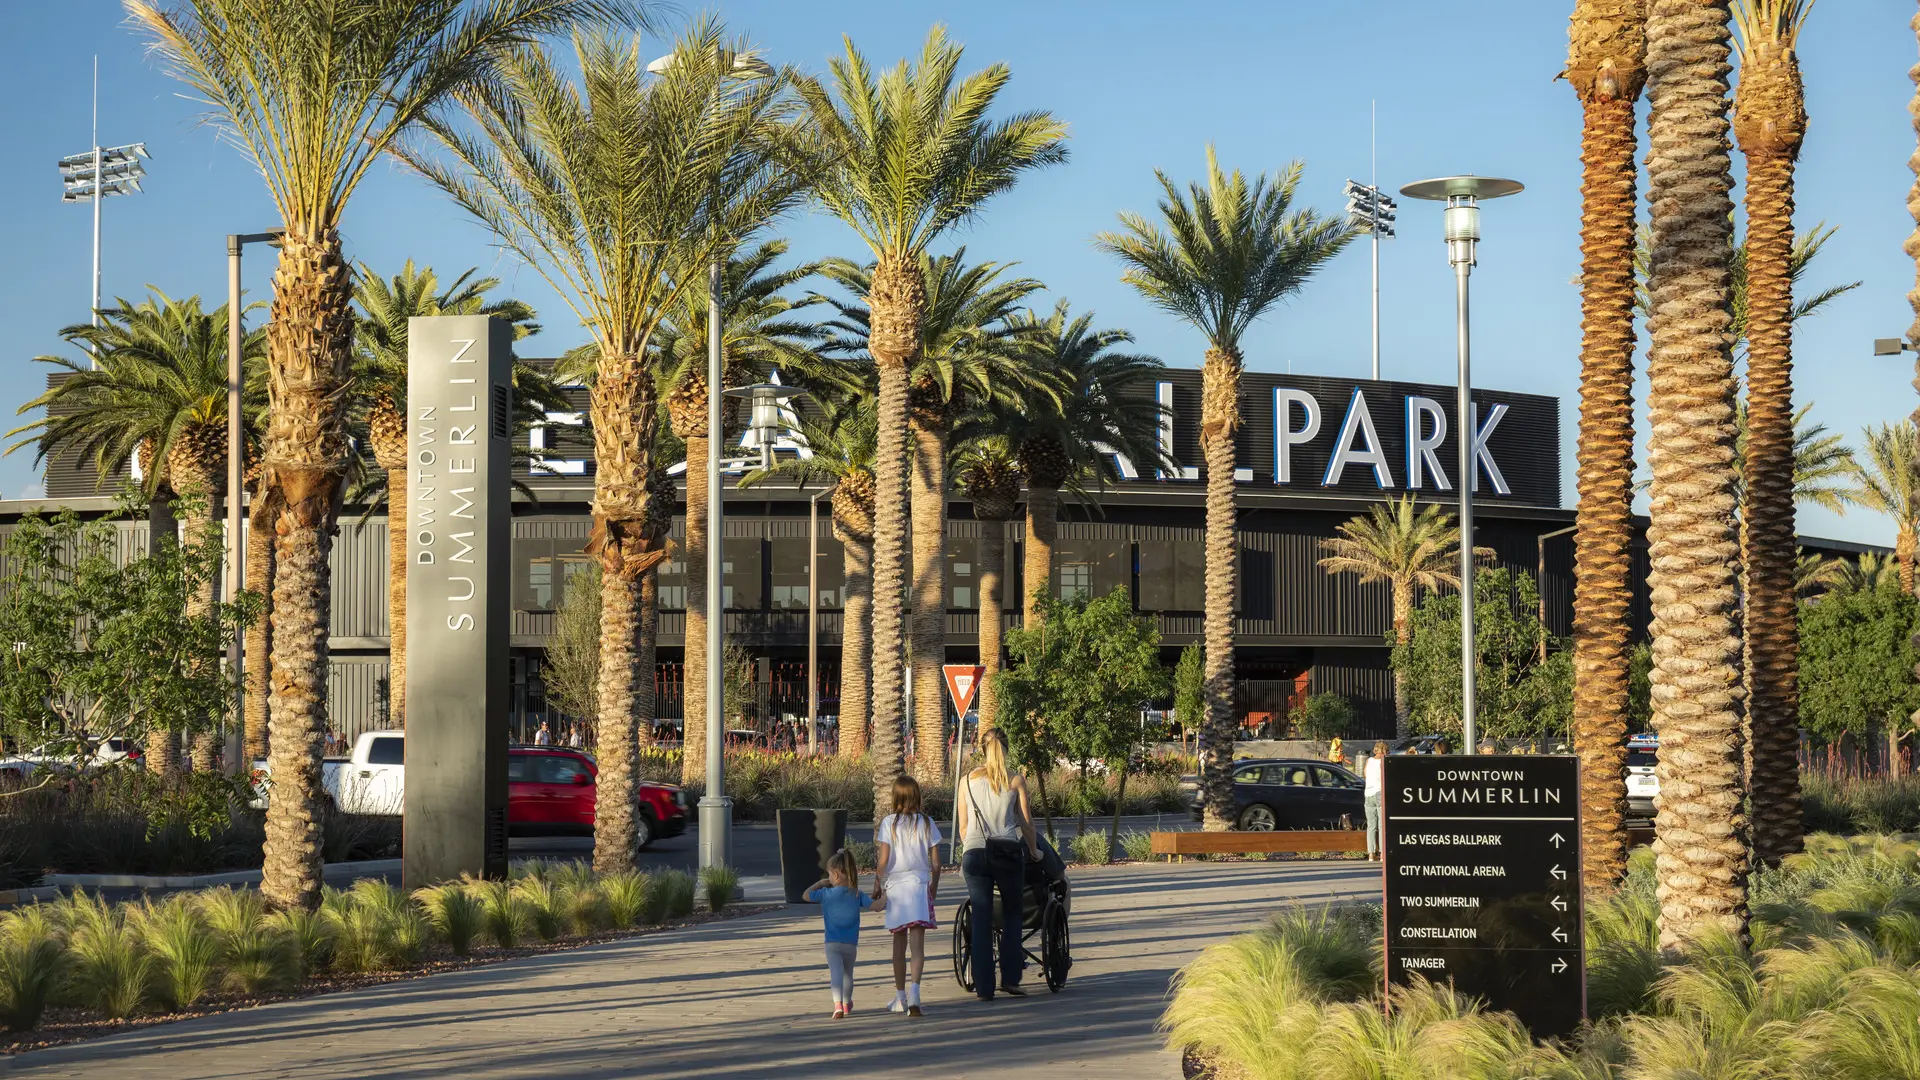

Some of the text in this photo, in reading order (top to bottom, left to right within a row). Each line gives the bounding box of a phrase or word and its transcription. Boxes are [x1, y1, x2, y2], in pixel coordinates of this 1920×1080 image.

[416, 406, 437, 566] DOWNTOWN
[447, 338, 478, 632] SUMMERLIN
[1437, 770, 1524, 781] DOWNTOWN
[1402, 787, 1560, 804] SUMMERLIN
[1399, 834, 1502, 846] LAS VEGAS BALLPARK
[1399, 865, 1506, 877] CITY NATIONAL ARENA
[1400, 896, 1480, 908] TWO SUMMERLIN
[1400, 927, 1477, 939] CONSTELLATION
[1401, 957, 1446, 969] TANAGER
